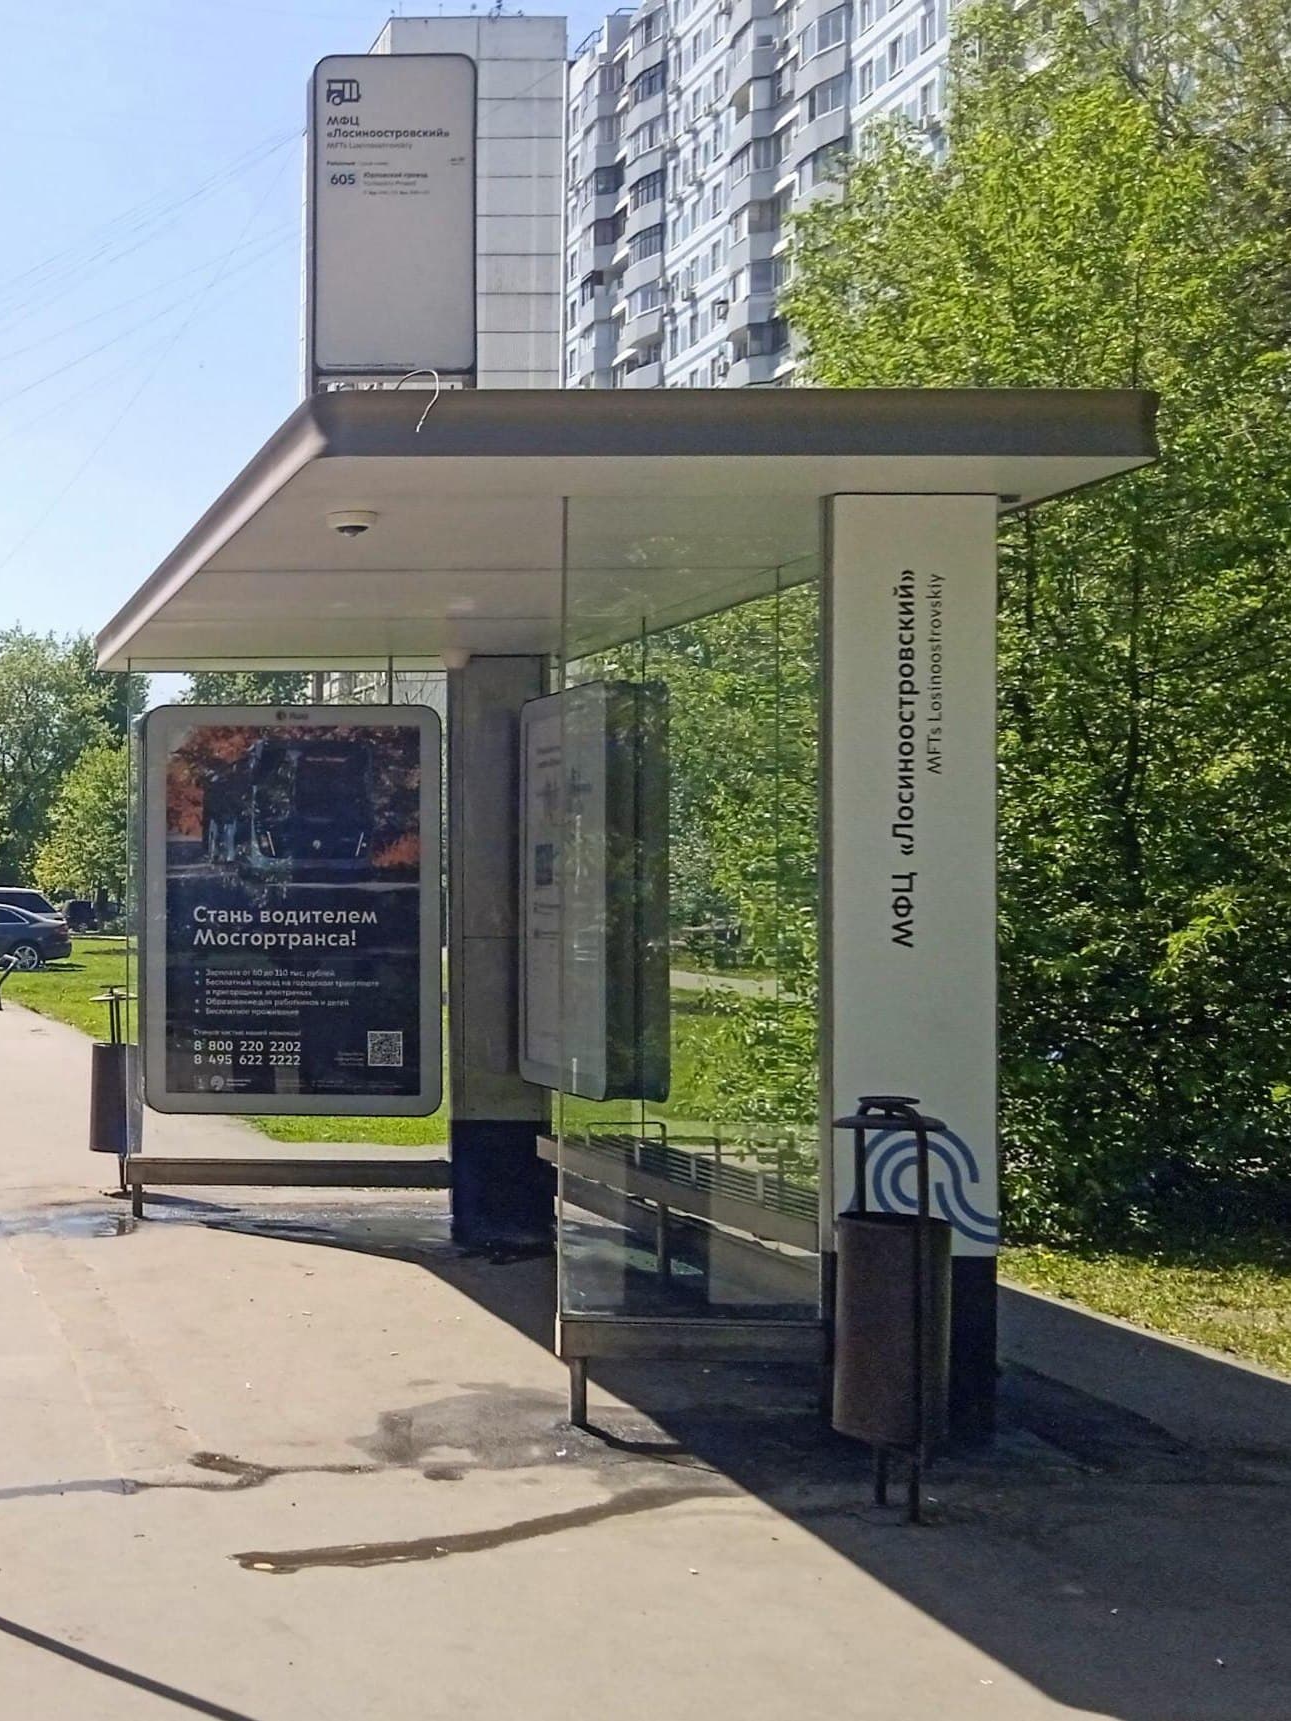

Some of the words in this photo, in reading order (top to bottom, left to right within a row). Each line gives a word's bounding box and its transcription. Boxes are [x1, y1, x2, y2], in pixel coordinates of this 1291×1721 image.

[326, 115, 360, 127] МФЦ
[326, 128, 450, 140] «Лосиноостровский»
[330, 174, 356, 185] 605
[925, 573, 946, 722] Losinoostrovskiy
[892, 569, 921, 856] «Лосиноостровский»
[926, 727, 943, 775] MFTs
[193, 905, 254, 924] Стань
[260, 909, 378, 926] водителем
[892, 872, 918, 948] МФЦ
[193, 928, 358, 950] Мосгортранса!
[193, 1040, 203, 1051] 8
[208, 1040, 234, 1051] 800
[239, 1041, 264, 1052] 220
[269, 1041, 302, 1052] 2202
[193, 1054, 203, 1065] 8
[208, 1054, 233, 1065] 495
[238, 1054, 263, 1065] 622
[268, 1054, 302, 1065] 2222
